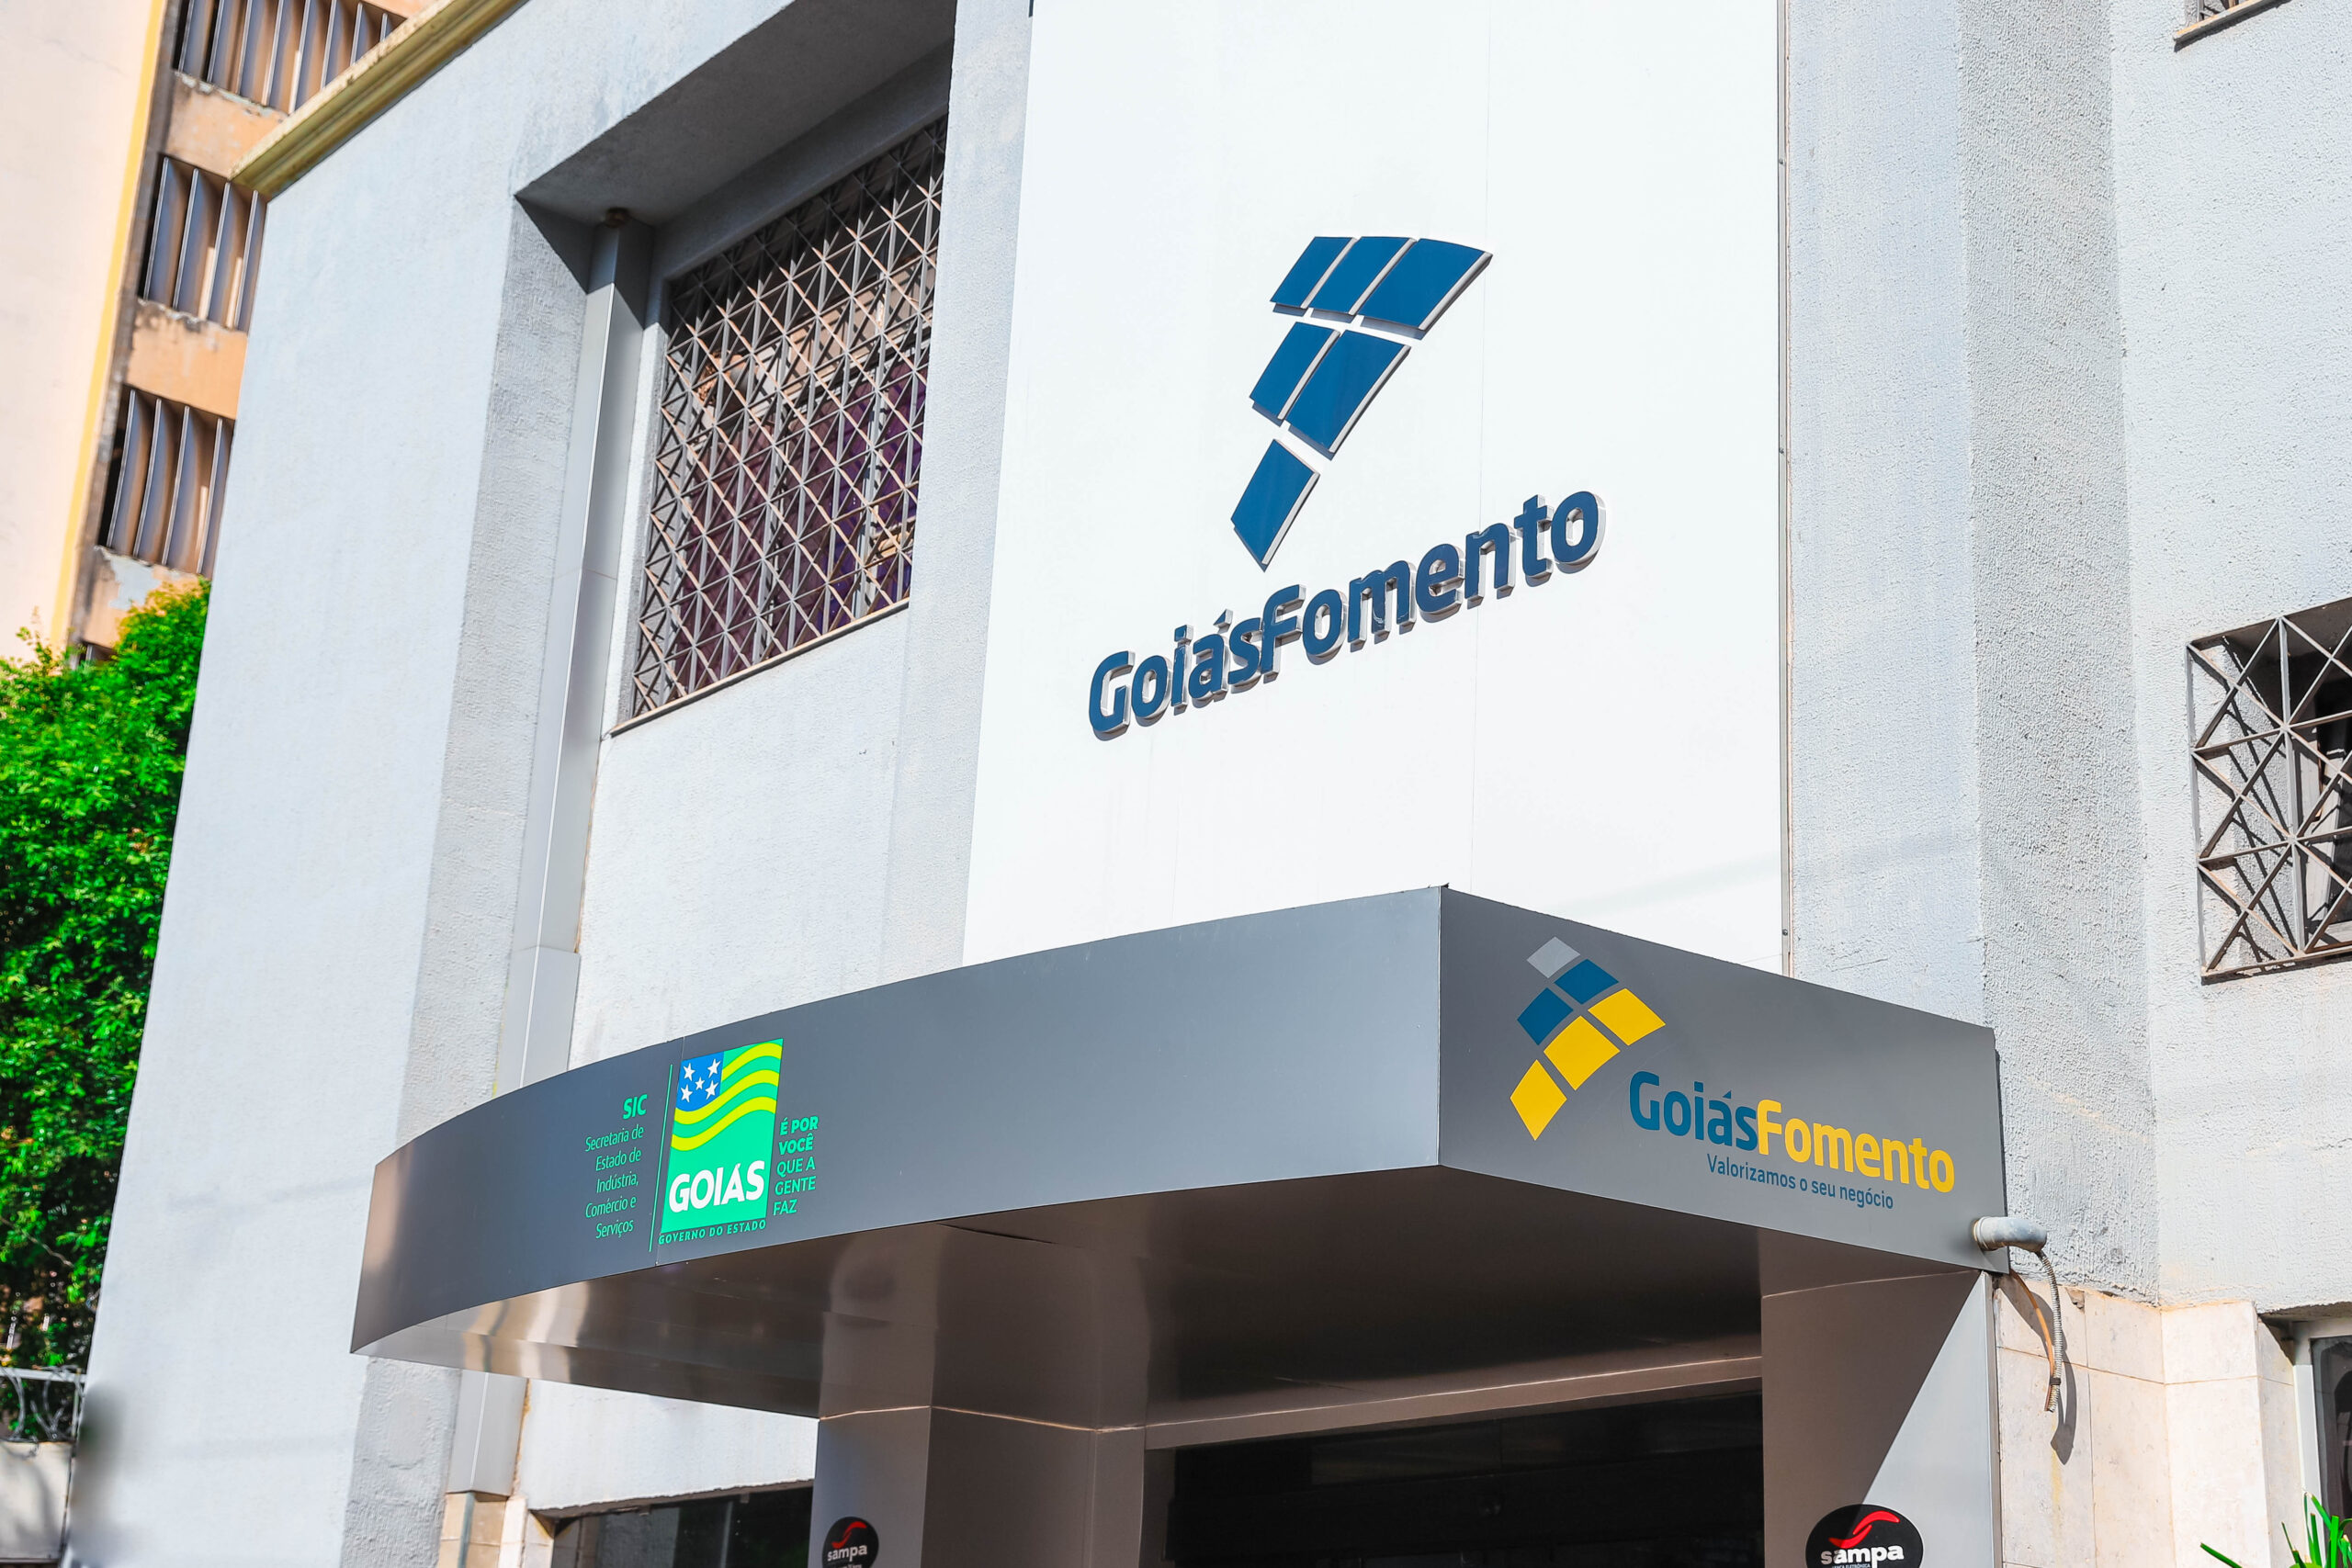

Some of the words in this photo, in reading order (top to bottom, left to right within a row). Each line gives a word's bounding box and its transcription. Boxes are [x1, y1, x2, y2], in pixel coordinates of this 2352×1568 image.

[1089, 491, 1603, 737] GoiásFomento
[623, 1094, 648, 1120] SIC
[779, 1117, 788, 1135] É
[791, 1116, 819, 1133] POR
[1630, 1071, 1955, 1193] GoiásFomento
[585, 1127, 629, 1152] Secretaria
[631, 1124, 644, 1139] de
[778, 1133, 814, 1155] VOCÊ
[595, 1150, 627, 1171] Estado
[628, 1148, 641, 1163] de
[776, 1161, 803, 1177] QUE
[806, 1156, 816, 1170] A
[596, 1172, 639, 1193] Indústria,
[669, 1160, 765, 1213] GOIÁS
[775, 1176, 817, 1196] GENTE
[1707, 1153, 1796, 1190] Valorizamos
[1799, 1177, 1808, 1191] o
[1811, 1179, 1836, 1198] seu
[1839, 1186, 1894, 1209] negócio
[585, 1196, 628, 1218] Comércio
[629, 1197, 637, 1209] e
[773, 1199, 797, 1215] FAZ
[595, 1219, 634, 1239] Serviços
[658, 1229, 706, 1245] GOVERNO
[709, 1225, 724, 1237] DO
[727, 1220, 766, 1235] ESTADO
[828, 1545, 867, 1562] sampa
[1821, 1545, 1905, 1568] sampa
